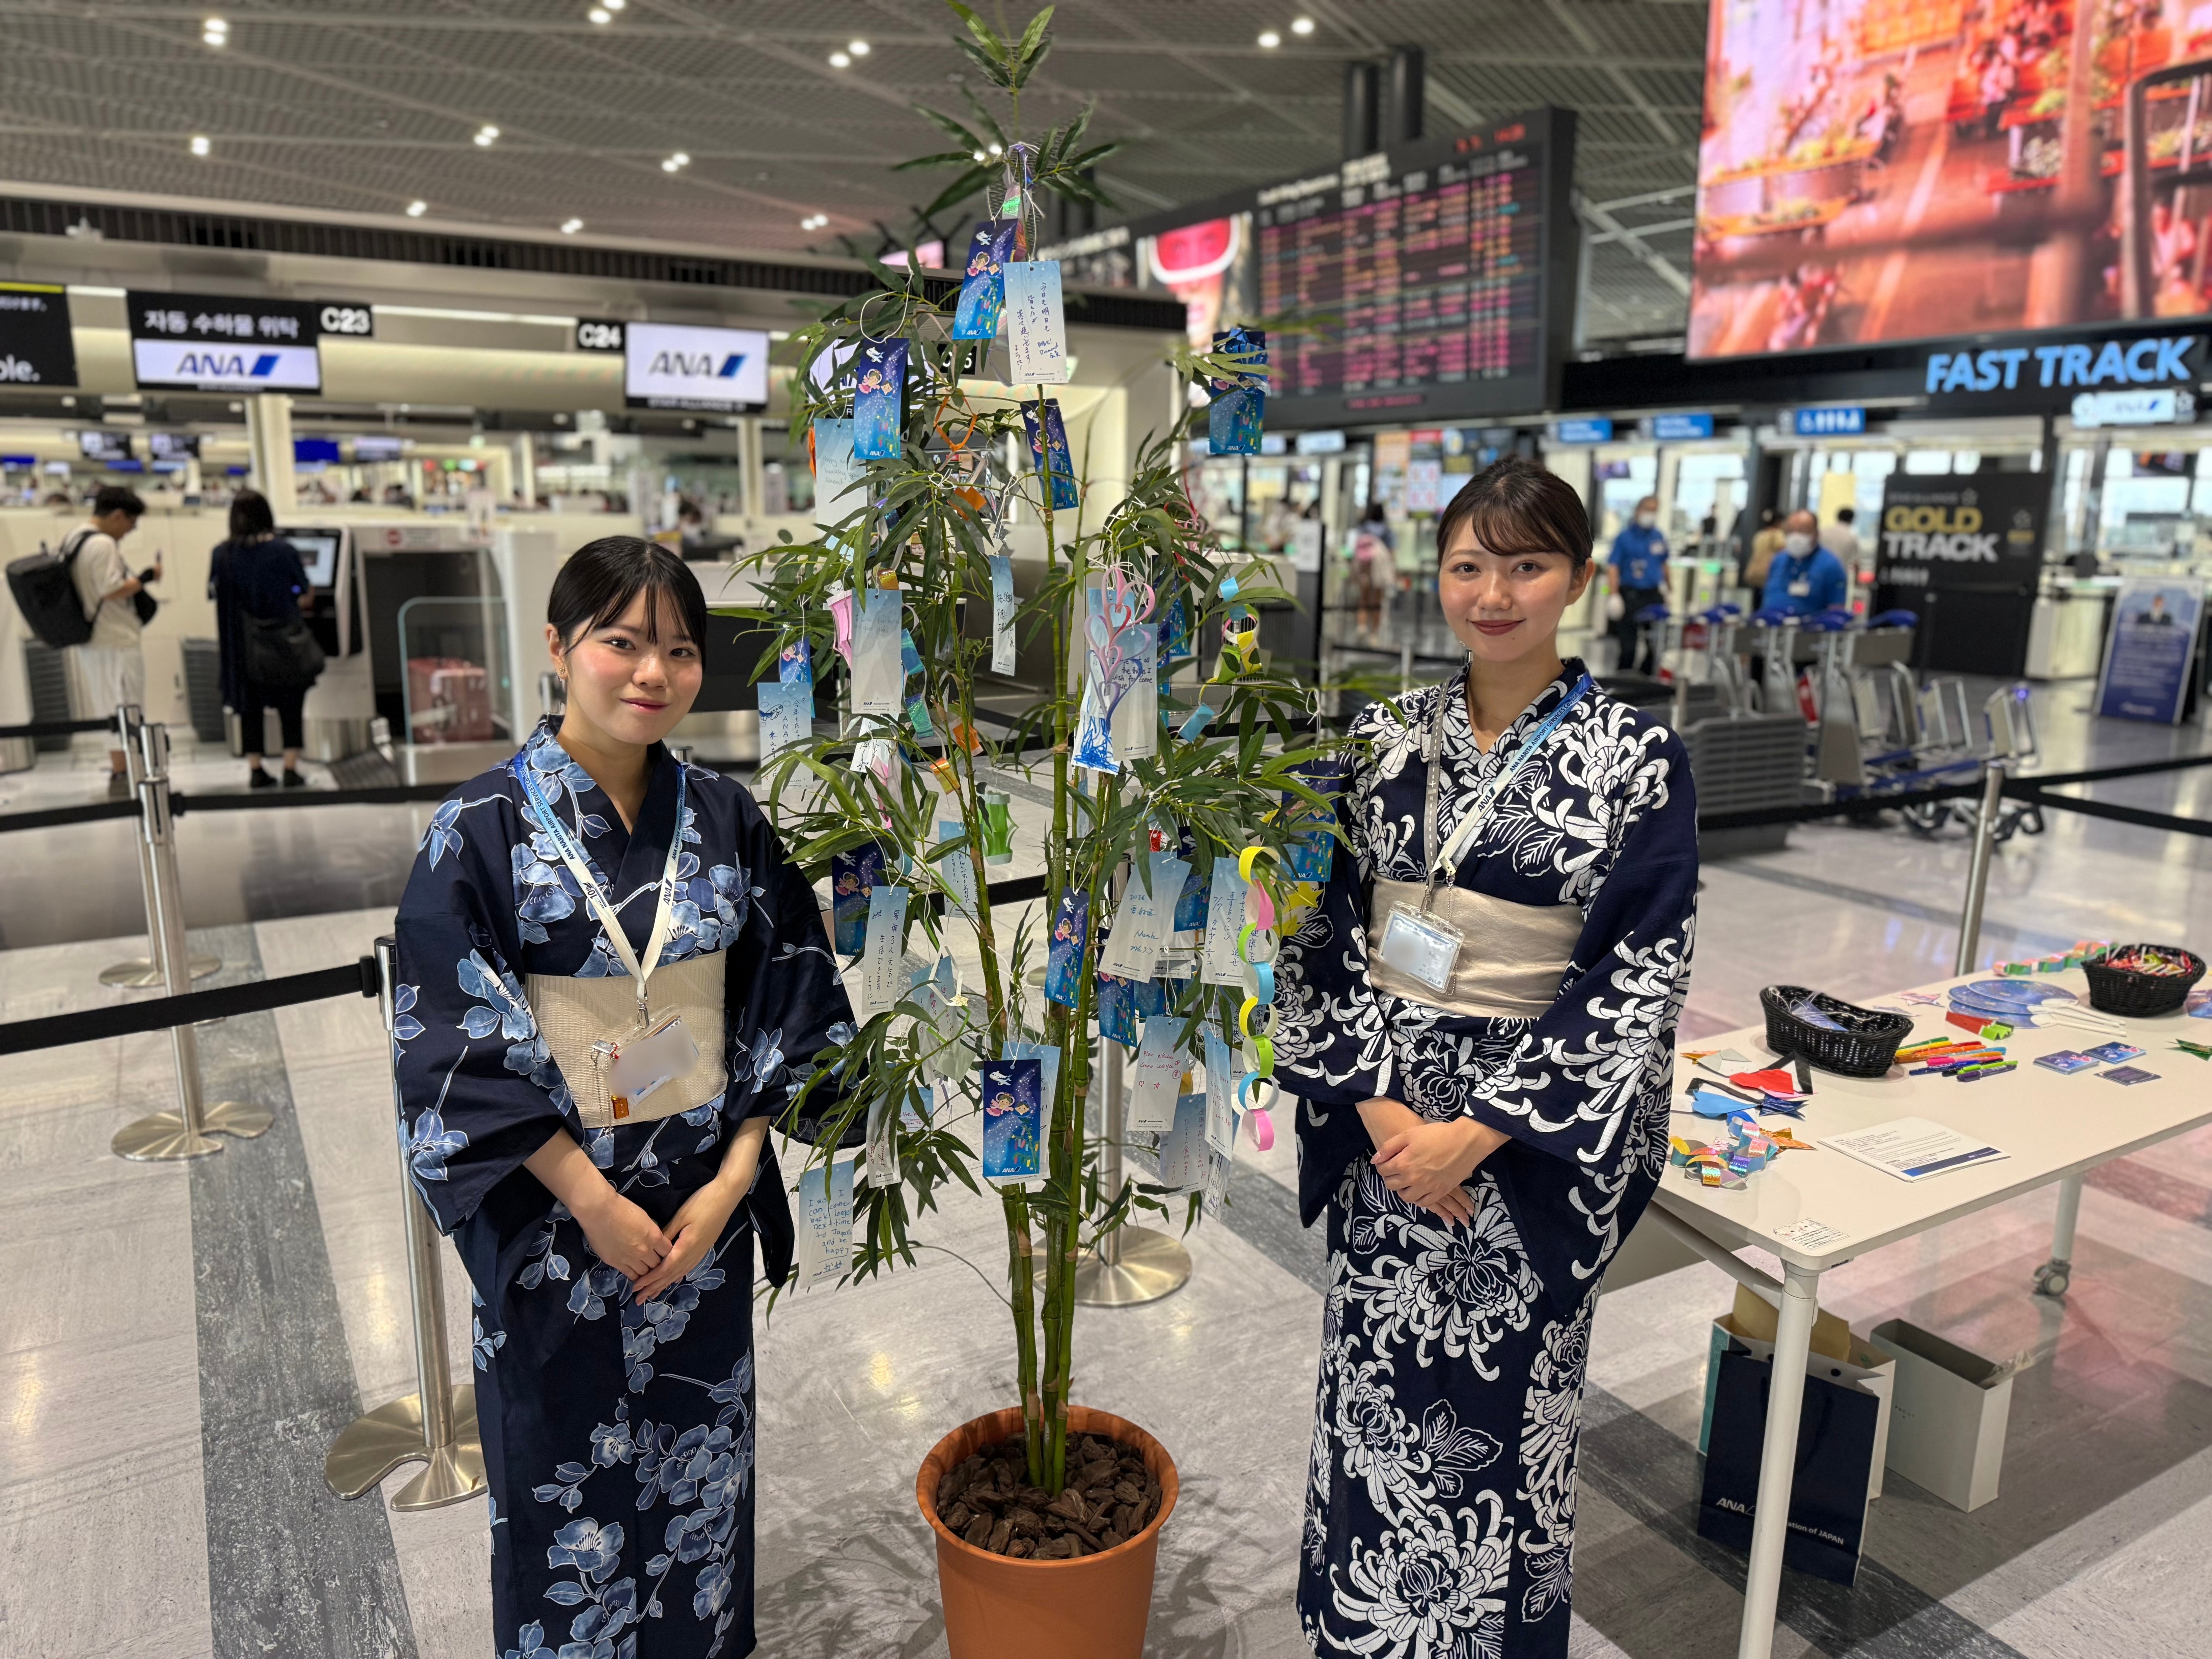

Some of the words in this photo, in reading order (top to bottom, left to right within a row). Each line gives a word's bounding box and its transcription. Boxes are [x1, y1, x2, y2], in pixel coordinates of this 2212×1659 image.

[144, 310, 187, 333] 자동
[193, 312, 254, 335] 수하물
[258, 314, 301, 338] 위탁
[320, 307, 370, 333] C23
[578, 324, 621, 347] C24
[177, 352, 244, 376] ANA
[649, 352, 712, 378] ANA
[1926, 348, 2028, 393] FAST
[2035, 337, 2195, 388] TRACK
[1885, 505, 1983, 533] GOLD
[1883, 532, 2000, 563] TRACK
[1510, 761, 1518, 773] ANA
[1518, 745, 1534, 762] NARITA
[1532, 726, 1549, 747] AIRPORT
[1547, 708, 1565, 728] SERVICES
[529, 784, 544, 809] SERVICES
[1477, 795, 1493, 812] ANA
[540, 809, 558, 831] AIRPORT
[553, 829, 569, 850] NARITA
[565, 848, 576, 860] ANA
[663, 887, 672, 905] ANA
[1213, 896, 1223, 912] 7/7
[809, 1207, 823, 1216] can
[811, 1213, 828, 1223] back
[835, 1208, 852, 1218] longer
[814, 1221, 832, 1230] next
[823, 1239, 834, 1247] and
[826, 1247, 849, 1256] happy
[1716, 1498, 1745, 1513] ANA
[1818, 1530, 1844, 1545] JAPAN
